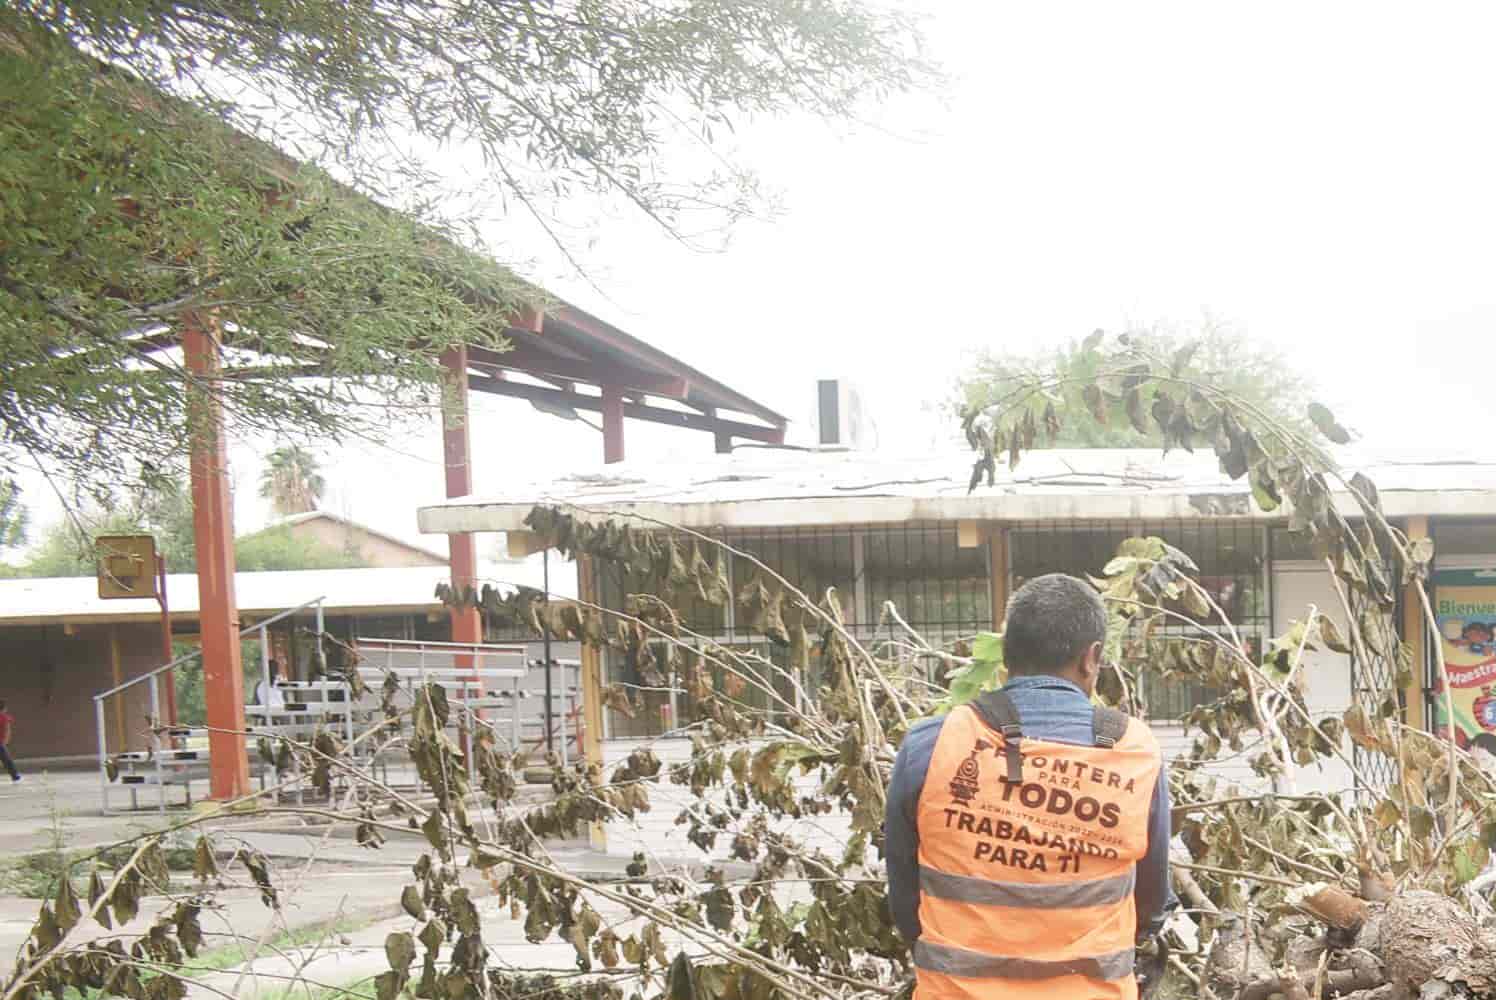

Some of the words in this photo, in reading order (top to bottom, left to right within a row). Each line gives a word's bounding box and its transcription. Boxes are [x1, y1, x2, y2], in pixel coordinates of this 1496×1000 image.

[994, 746, 1136, 794] FONTERA
[1039, 772, 1081, 791] PARA
[998, 776, 1121, 828] TODOS
[943, 808, 1119, 860] TRABAJANDO
[974, 842, 1047, 873] PARA
[1057, 855, 1081, 874] TI
